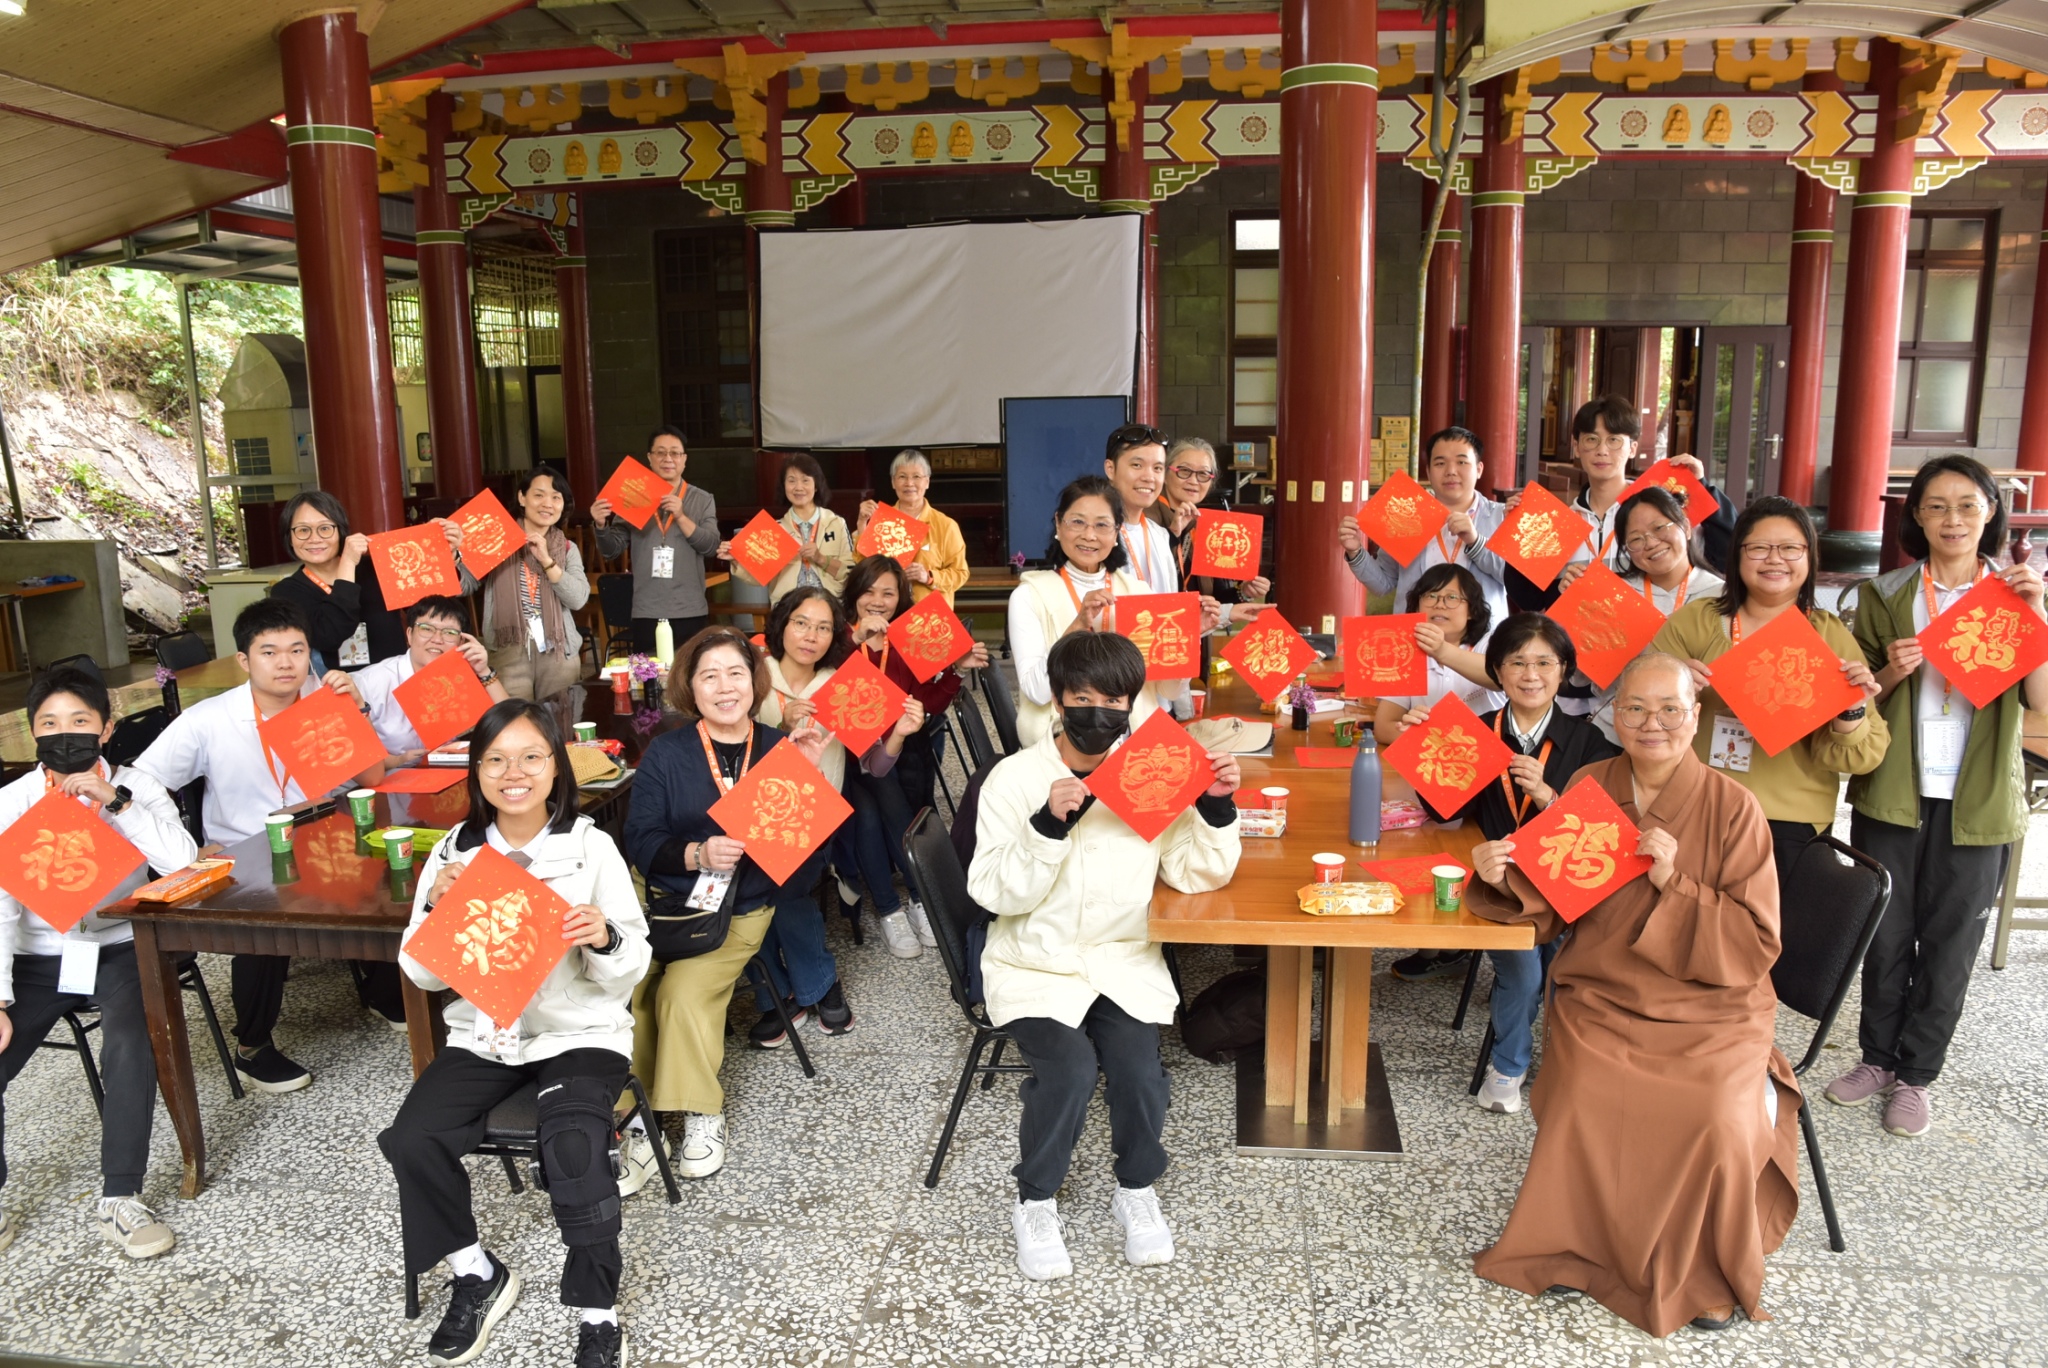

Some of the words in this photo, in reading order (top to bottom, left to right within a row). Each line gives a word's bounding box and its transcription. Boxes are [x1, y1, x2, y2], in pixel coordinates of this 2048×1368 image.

[1210, 534, 1247, 552] 新年好
[1362, 643, 1408, 661] 新年好
[1948, 606, 2022, 670] 福
[291, 711, 355, 768] 福
[19, 828, 100, 893] 福
[1538, 813, 1621, 890] 福
[454, 888, 539, 977] 福
